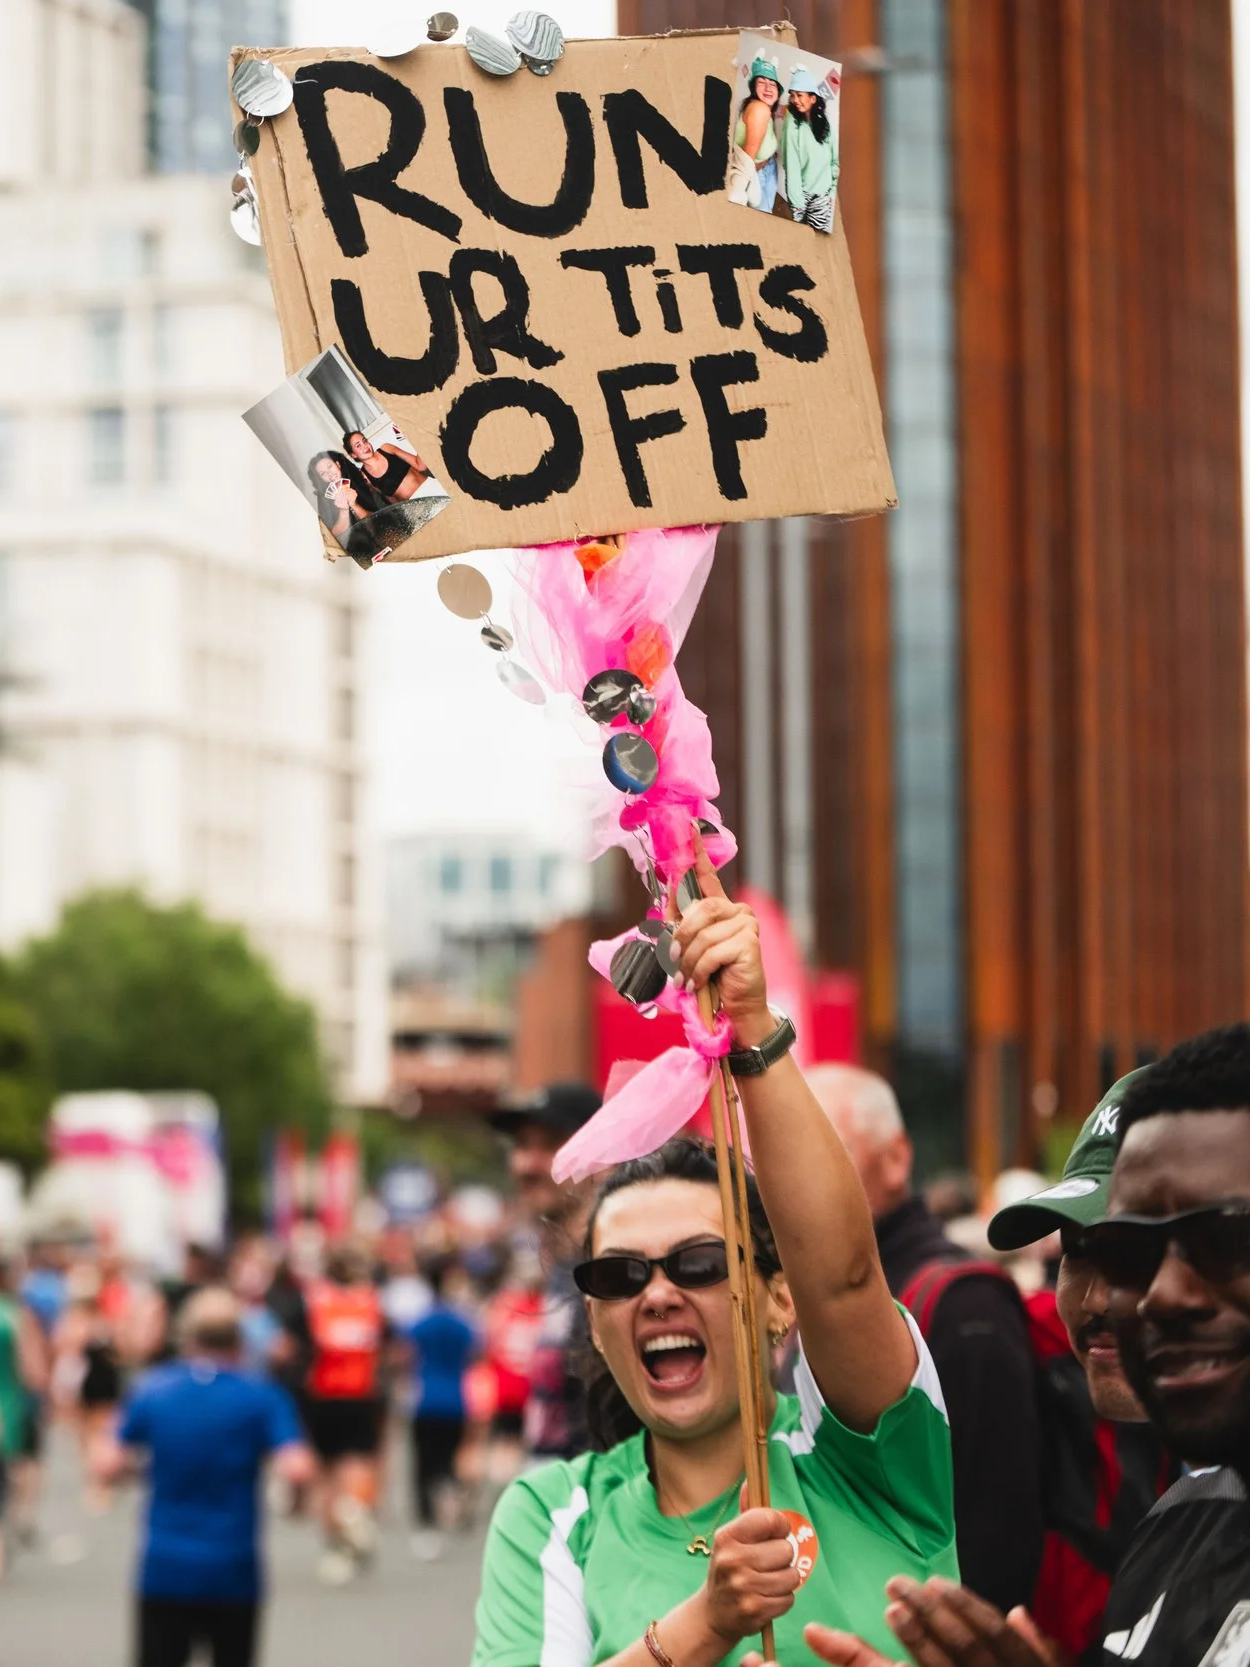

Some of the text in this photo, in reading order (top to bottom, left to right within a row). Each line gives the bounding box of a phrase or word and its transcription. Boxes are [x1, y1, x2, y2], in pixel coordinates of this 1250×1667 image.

[293, 60, 733, 259] RUN
[331, 247, 566, 397] UR
[438, 350, 768, 511] OFF
